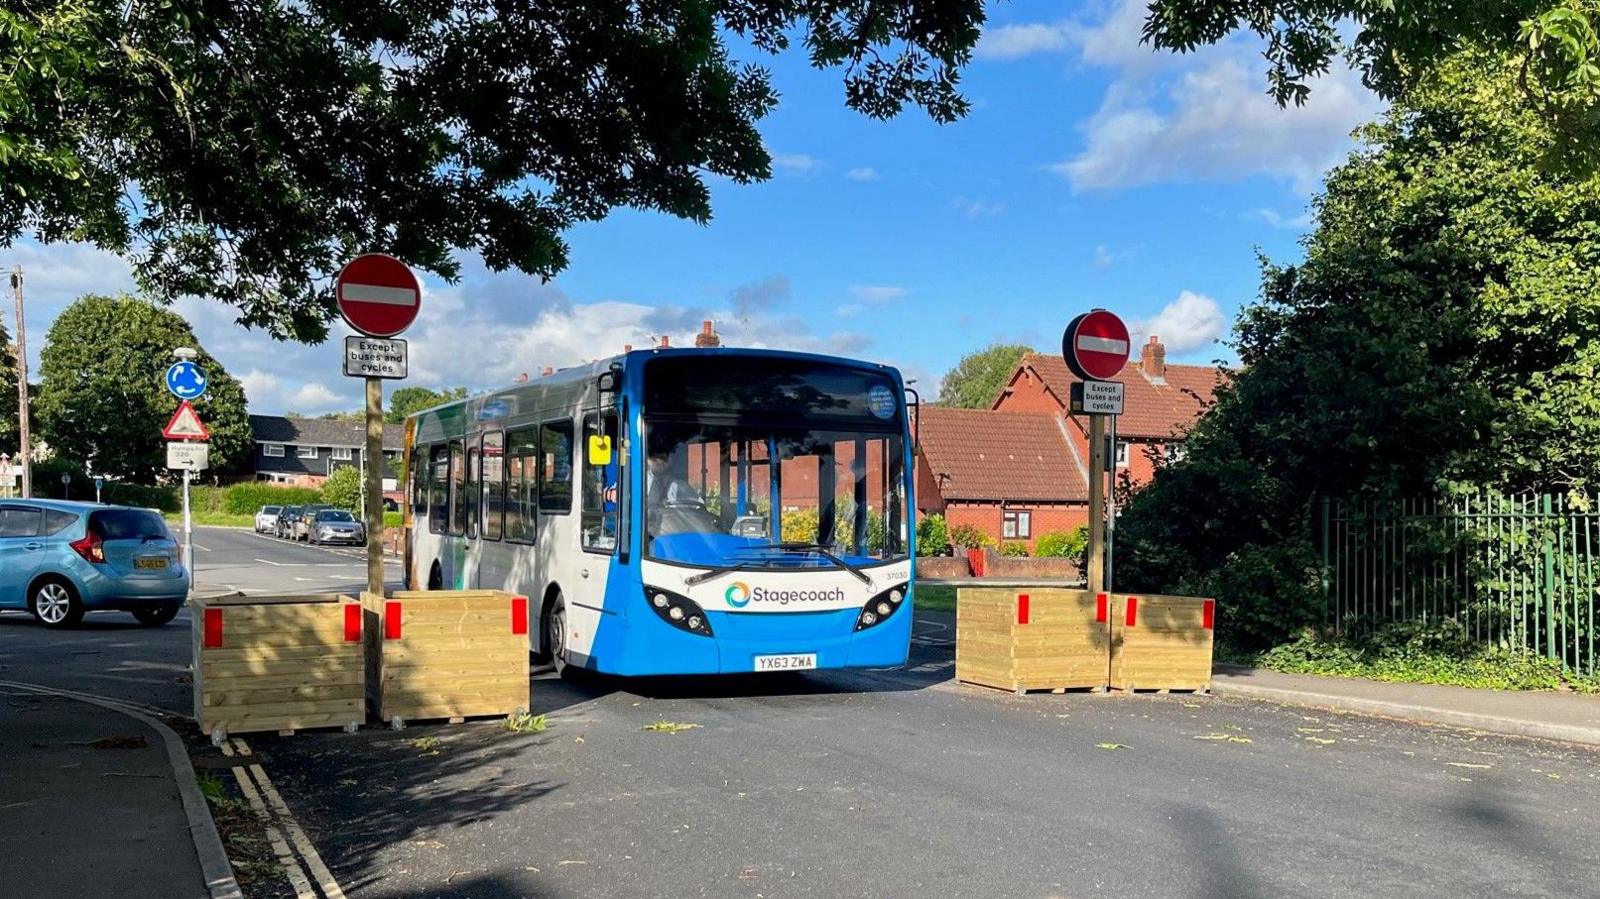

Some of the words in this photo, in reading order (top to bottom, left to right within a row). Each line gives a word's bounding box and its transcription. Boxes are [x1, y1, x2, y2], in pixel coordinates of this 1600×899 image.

[359, 341, 394, 353] Except
[351, 351, 381, 361] buses
[384, 354, 403, 363] and
[361, 364, 393, 373] cycles
[1091, 383, 1116, 393] Except
[1085, 392, 1106, 400] buses
[1092, 402, 1114, 410] cycles
[753, 586, 845, 605] Stagecoach
[760, 657, 789, 669] YX63
[791, 656, 812, 668] ZWA
